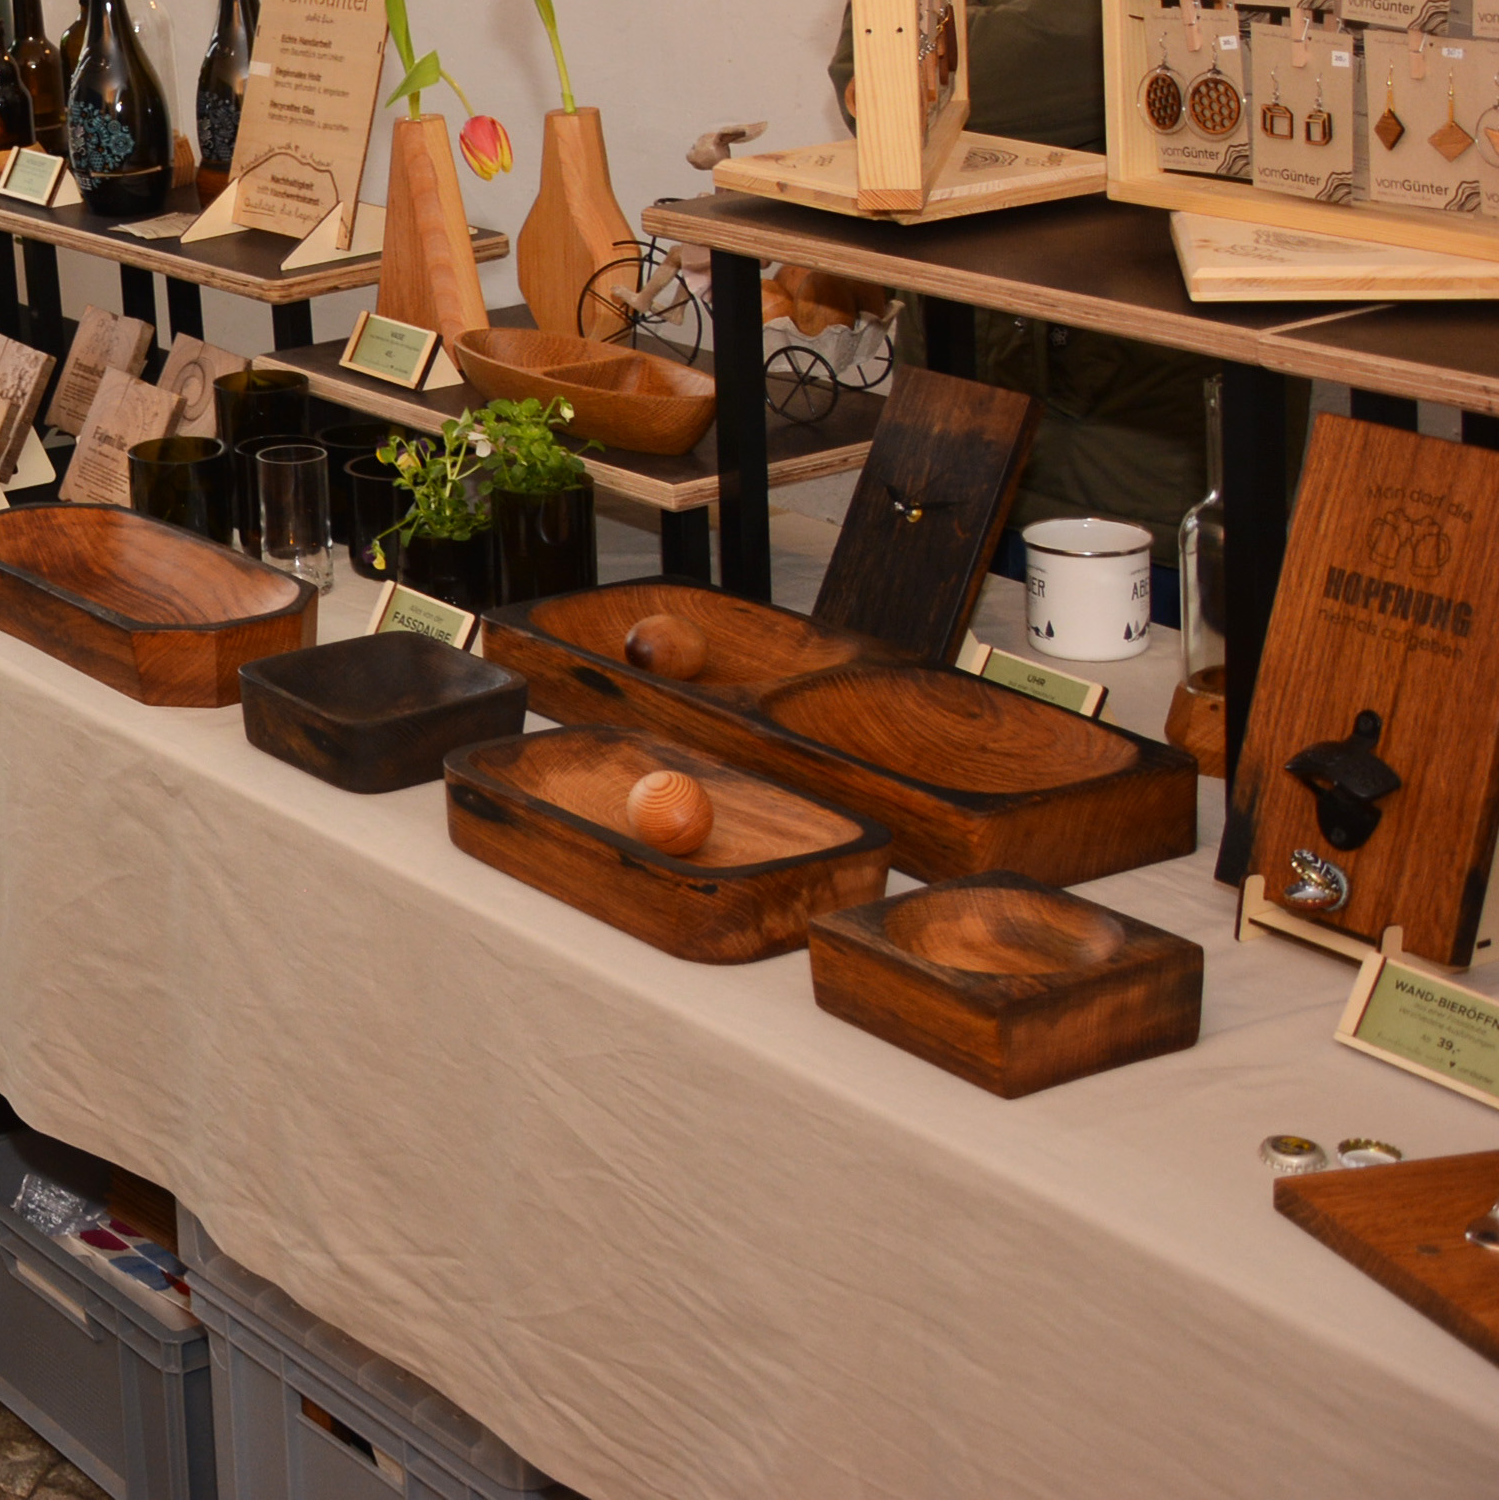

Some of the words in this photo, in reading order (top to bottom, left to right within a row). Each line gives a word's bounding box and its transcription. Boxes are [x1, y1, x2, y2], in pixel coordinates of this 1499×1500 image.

[1160, 146, 1220, 161] vomGünter
[1257, 166, 1322, 187] vomGünter
[1375, 177, 1450, 197] vomGünter
[1410, 488, 1446, 508] darf
[1448, 502, 1473, 524] die
[1323, 564, 1473, 638] HOPFNUNG
[392, 611, 452, 644] FASSDAUBE
[1318, 607, 1379, 636] niemals
[1381, 626, 1464, 659] aufgeben
[1026, 674, 1046, 687] UHR
[1437, 1036, 1461, 1054] 39,-
